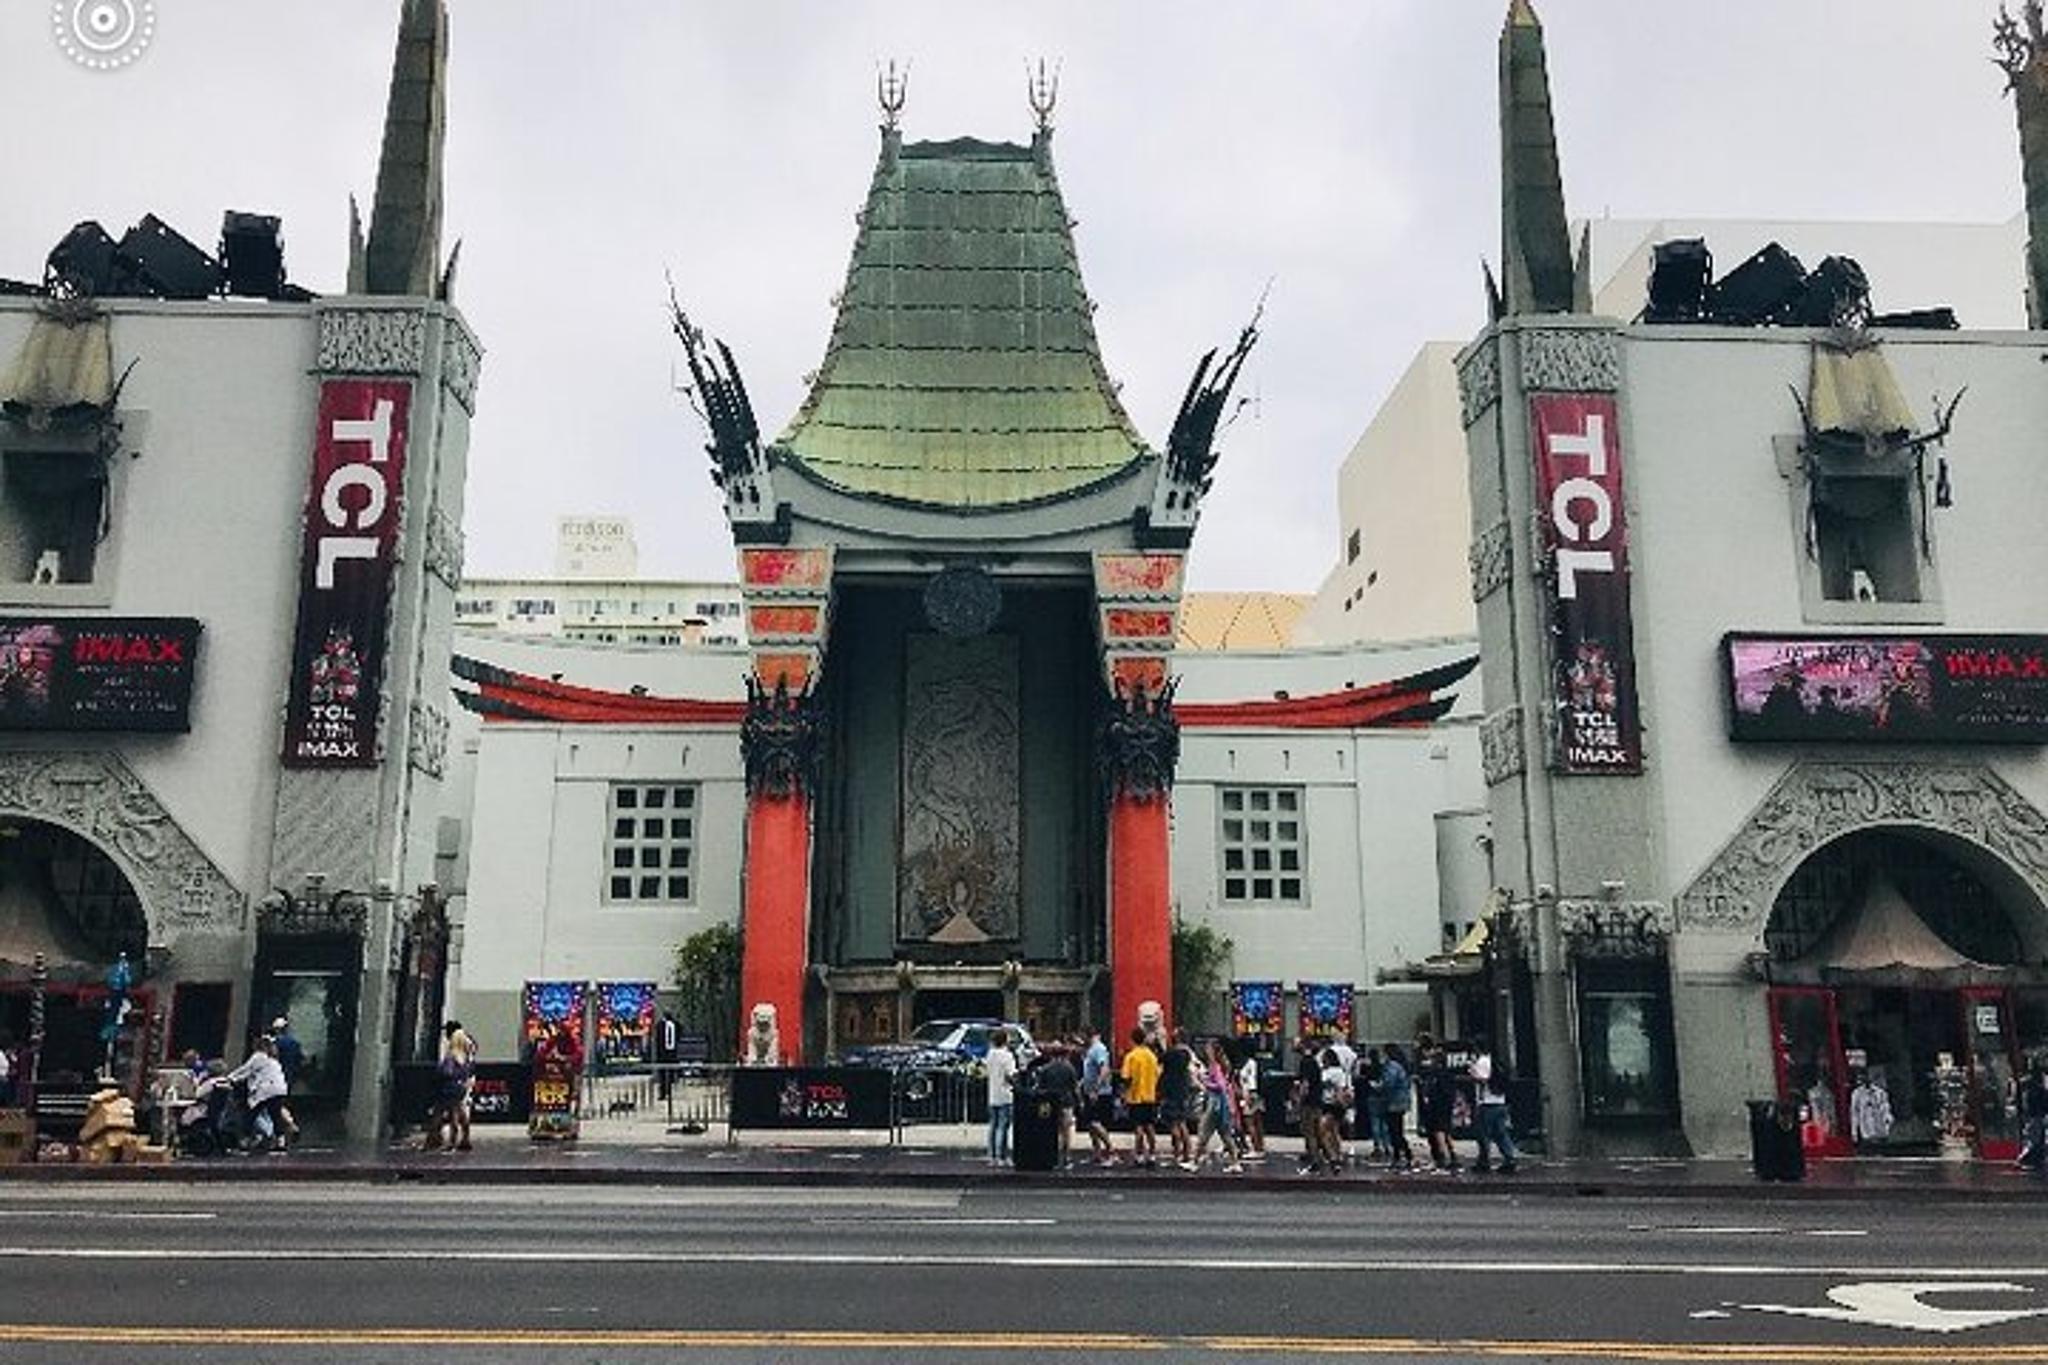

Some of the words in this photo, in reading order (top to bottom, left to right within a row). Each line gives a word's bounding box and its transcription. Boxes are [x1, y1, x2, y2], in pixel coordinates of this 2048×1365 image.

[316, 400, 394, 588] TCL
[1548, 414, 1615, 599] TCL
[74, 636, 183, 661] IMAX
[1946, 655, 2047, 678] IMAX
[310, 705, 356, 720] TCL
[1572, 713, 1617, 727] TCL
[297, 742, 359, 757] IMAX
[1568, 747, 1627, 763] IMAX
